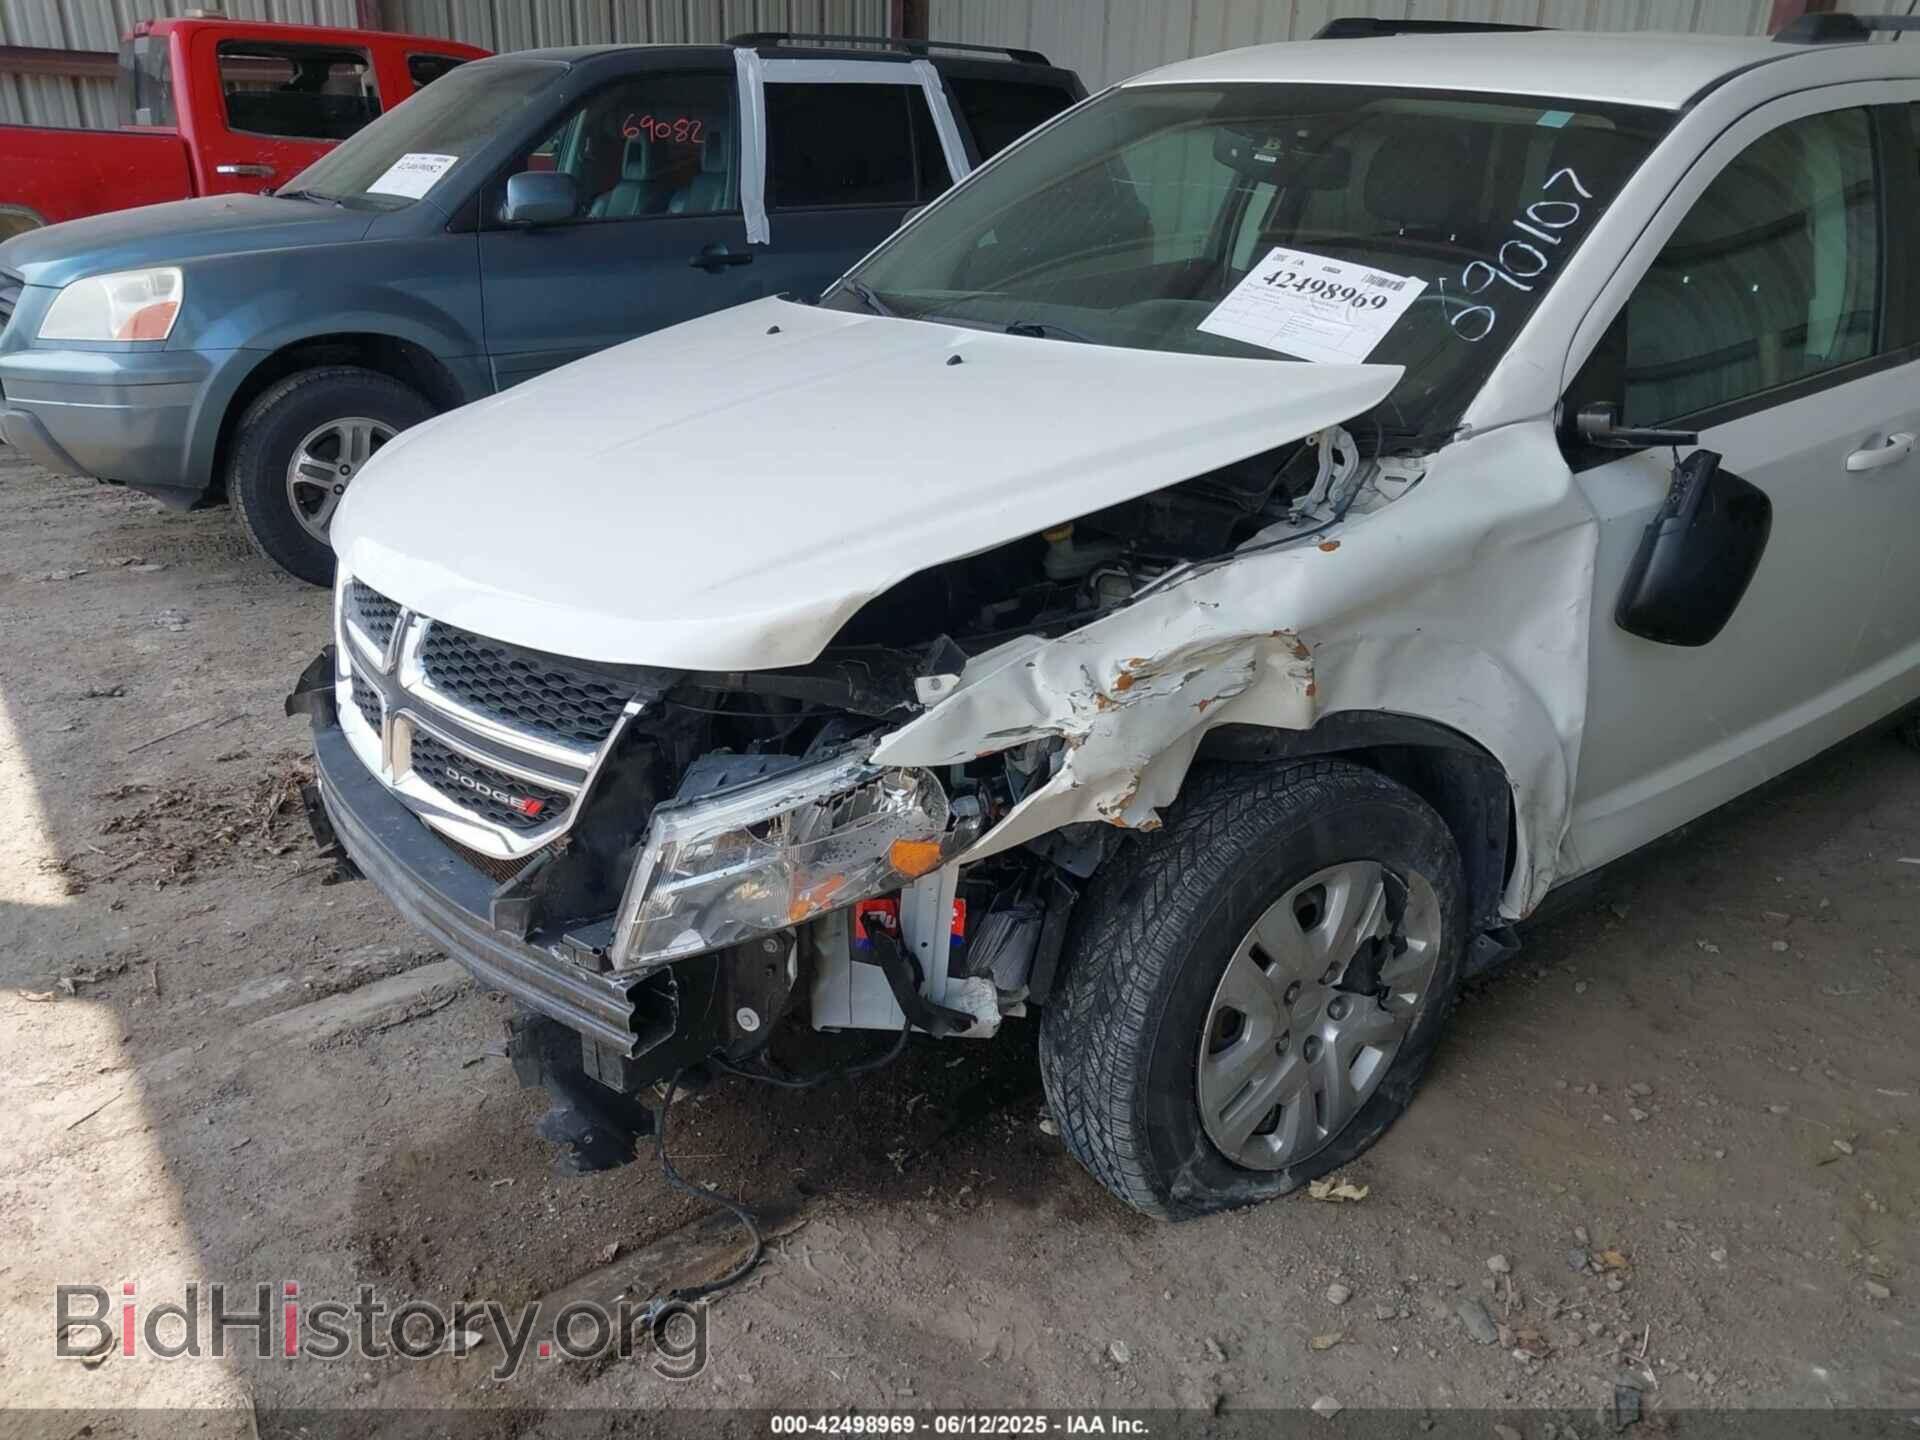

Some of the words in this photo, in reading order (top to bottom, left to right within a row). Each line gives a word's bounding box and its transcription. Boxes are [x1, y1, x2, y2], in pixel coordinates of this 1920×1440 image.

[623, 113, 705, 143] 69082
[1263, 269, 1389, 311] 42498969
[446, 767, 527, 811] DODGE
